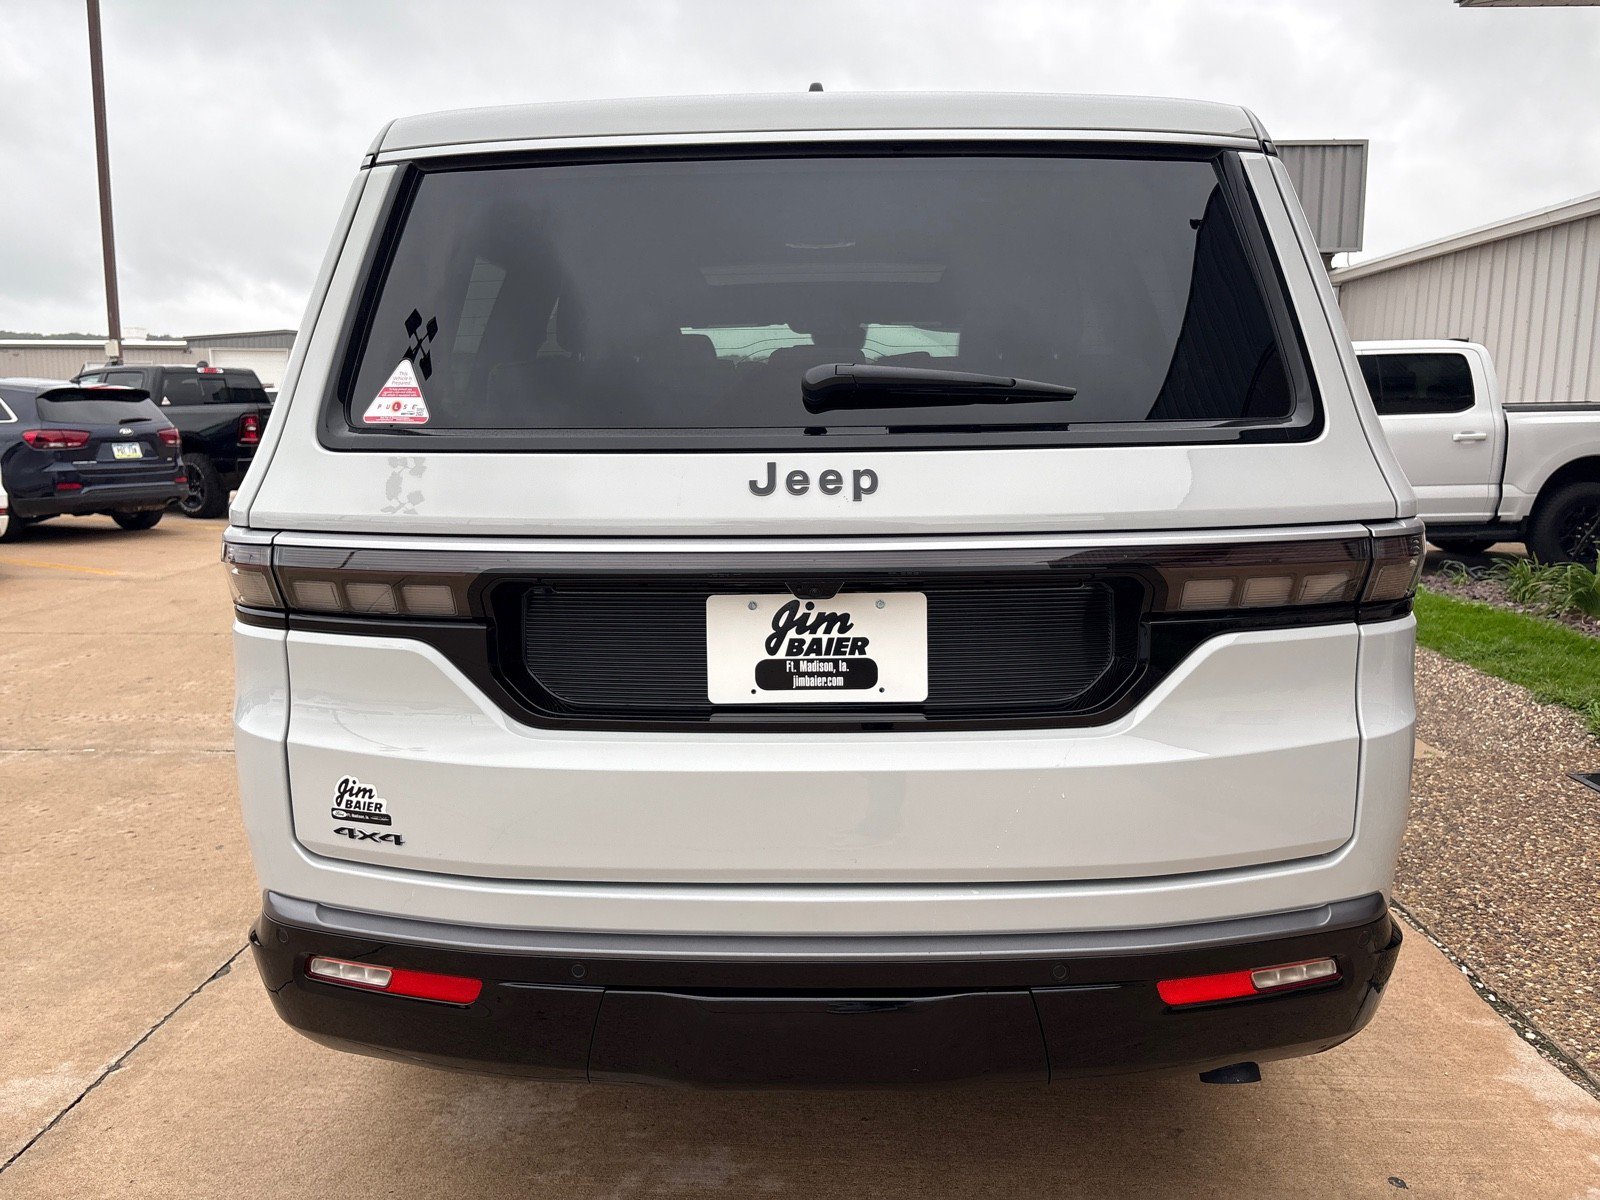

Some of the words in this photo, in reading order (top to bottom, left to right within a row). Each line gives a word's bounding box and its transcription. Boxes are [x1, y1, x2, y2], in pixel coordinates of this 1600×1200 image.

[748, 461, 879, 502] Jeep
[765, 599, 854, 657] Jim
[785, 636, 870, 657] BAIER
[786, 660, 797, 673] Ft.
[799, 660, 837, 674] Madison,
[792, 674, 844, 689] jimbaier.com
[335, 777, 376, 807] Jim
[345, 799, 384, 812] BAIER
